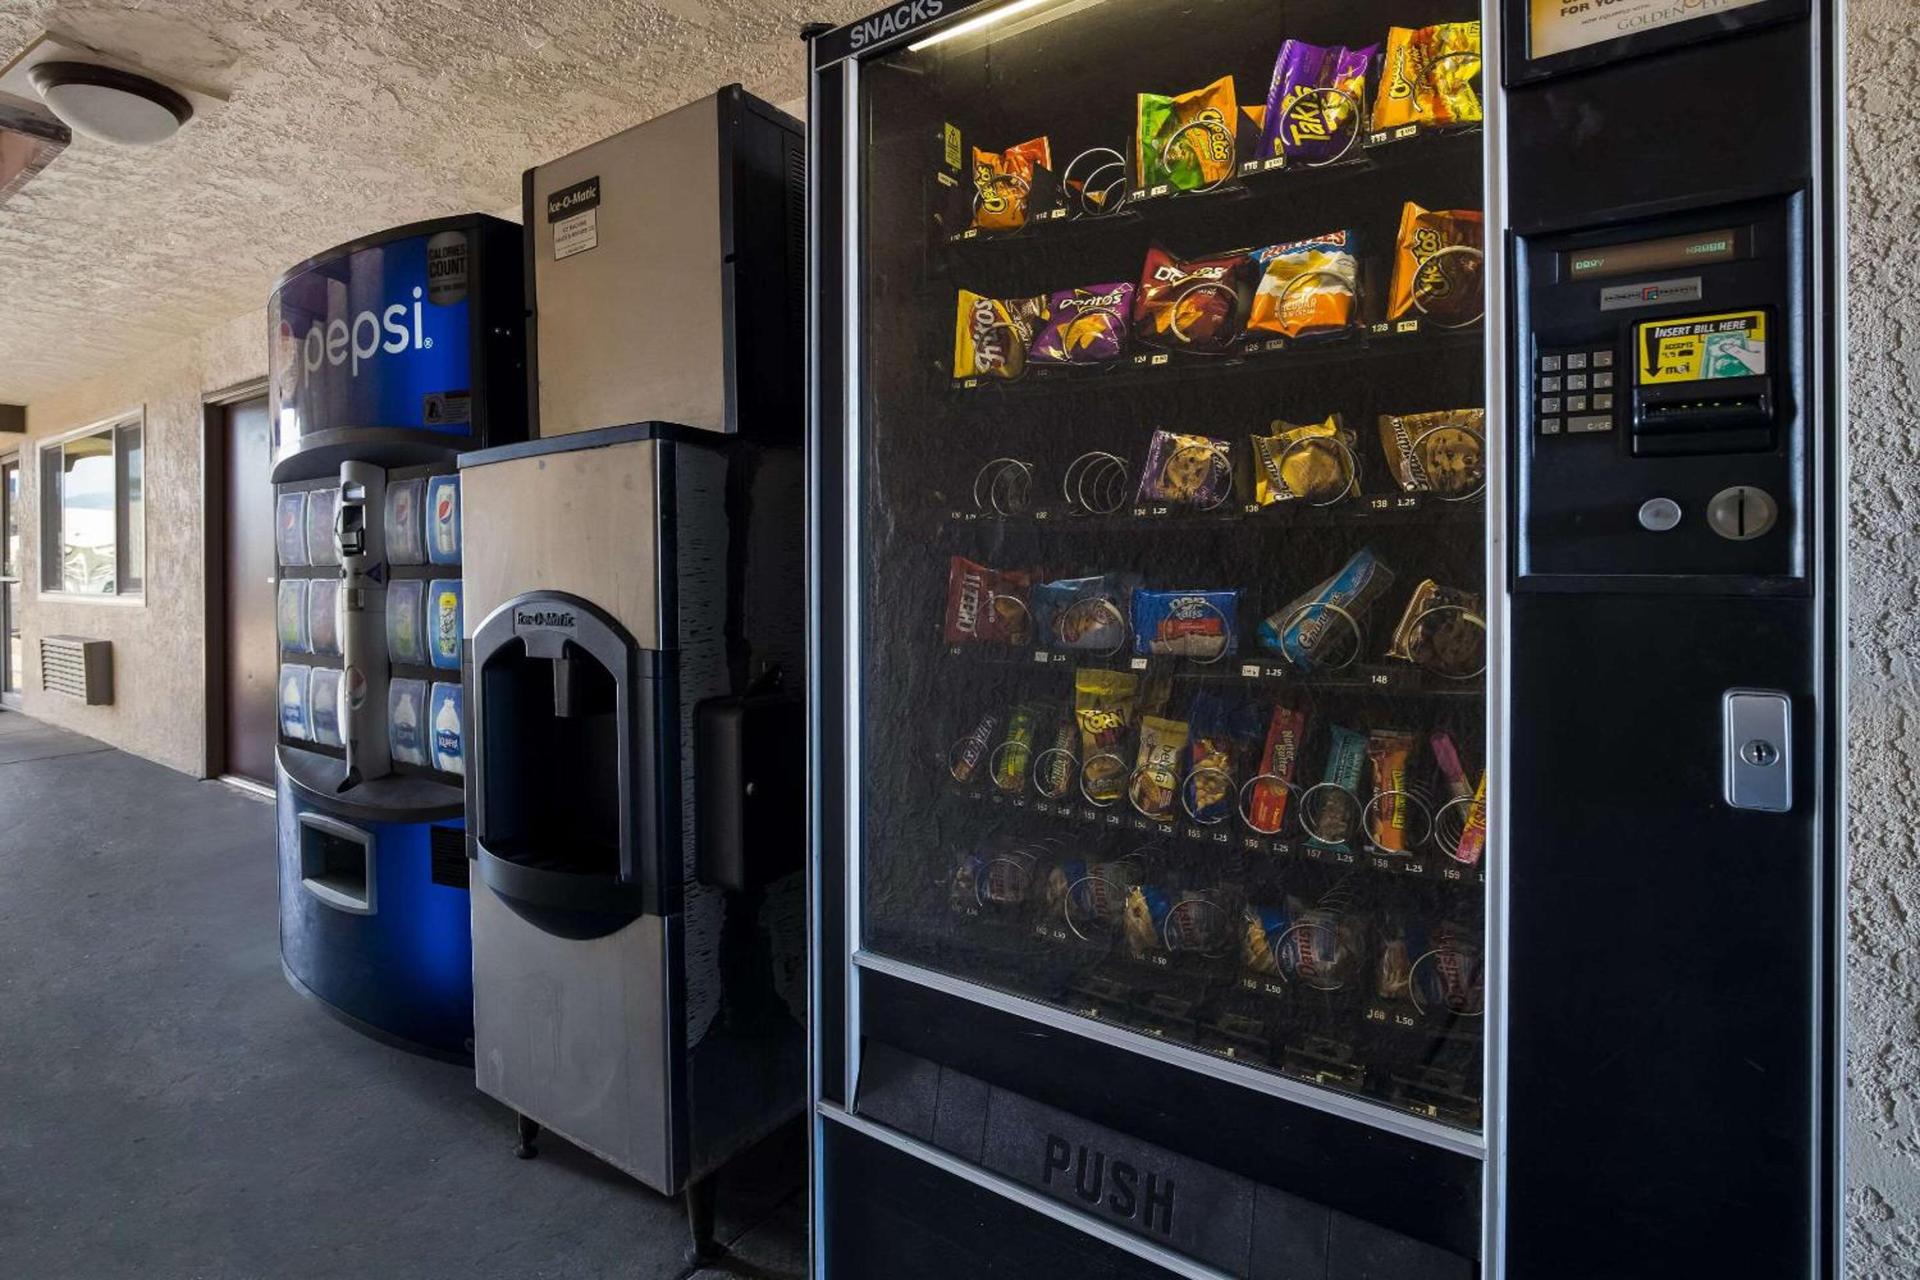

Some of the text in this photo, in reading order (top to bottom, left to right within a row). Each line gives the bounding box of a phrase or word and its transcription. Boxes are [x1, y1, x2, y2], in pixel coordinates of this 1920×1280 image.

[1560, 3, 1590, 17] FOR
[1617, 6, 1686, 31] GOLDEN
[850, 0, 943, 48] SNACKS
[1289, 85, 1331, 146] Takis
[428, 257, 466, 278] COUNT
[1060, 294, 1123, 310] Doritos
[1655, 319, 1748, 339] INSERT BILL HERE
[1370, 500, 1388, 510] 138
[1371, 674, 1388, 685] 148
[1306, 847, 1355, 864] 157 1.25
[1404, 863, 1424, 873] 1.25
[1393, 1014, 1415, 1027] 1.50
[1044, 1134, 1176, 1238] PUSH
